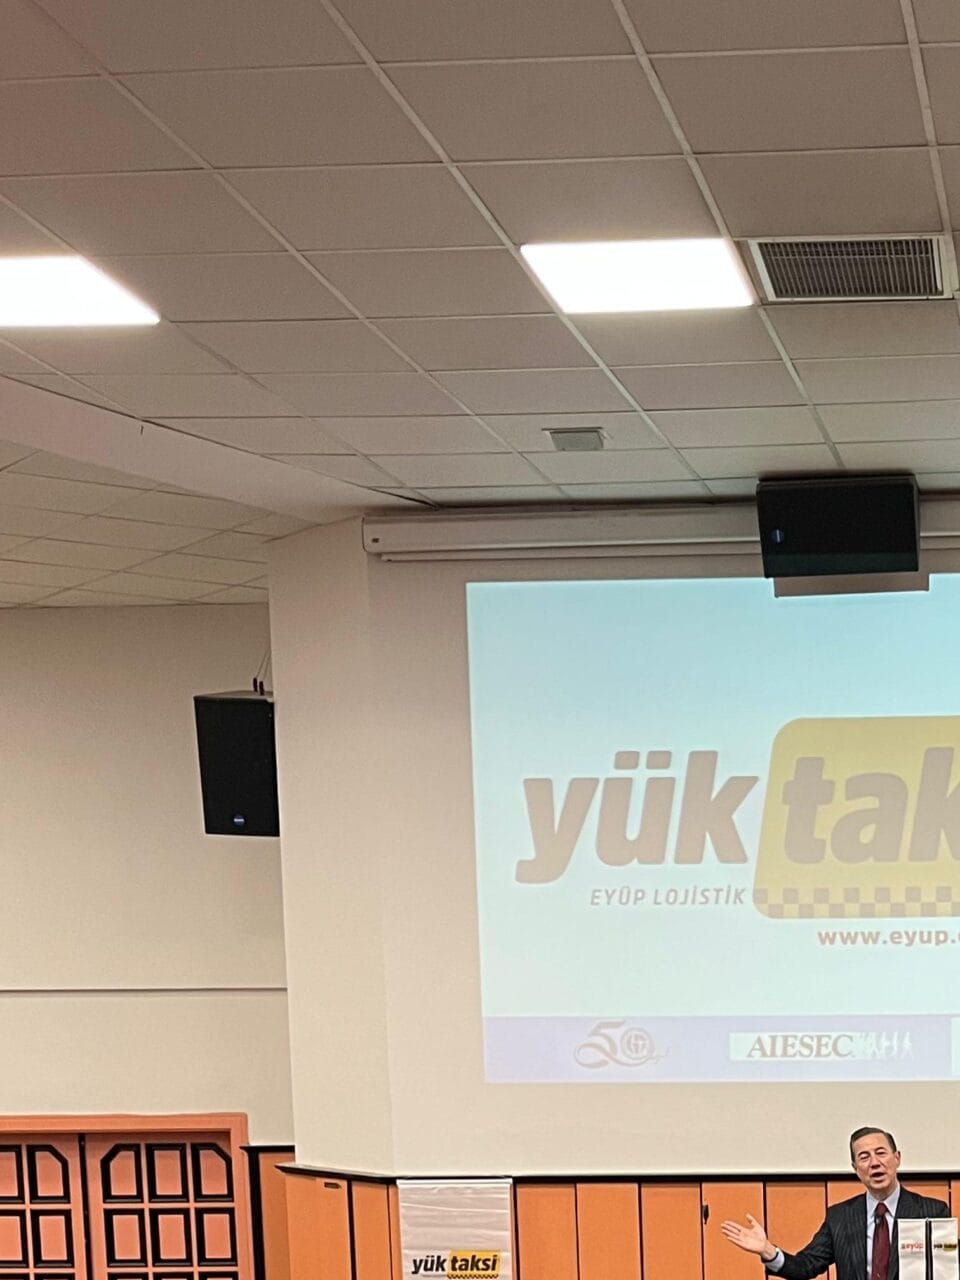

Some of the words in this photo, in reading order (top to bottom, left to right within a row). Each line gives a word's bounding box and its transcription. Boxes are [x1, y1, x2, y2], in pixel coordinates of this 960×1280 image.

[515, 750, 758, 884] yük
[590, 887, 646, 906] EYÜP
[652, 886, 746, 906] LOJİSTİK
[746, 1034, 855, 1059] AIESEC
[411, 1255, 447, 1274] yük
[450, 1254, 498, 1272] taksi
